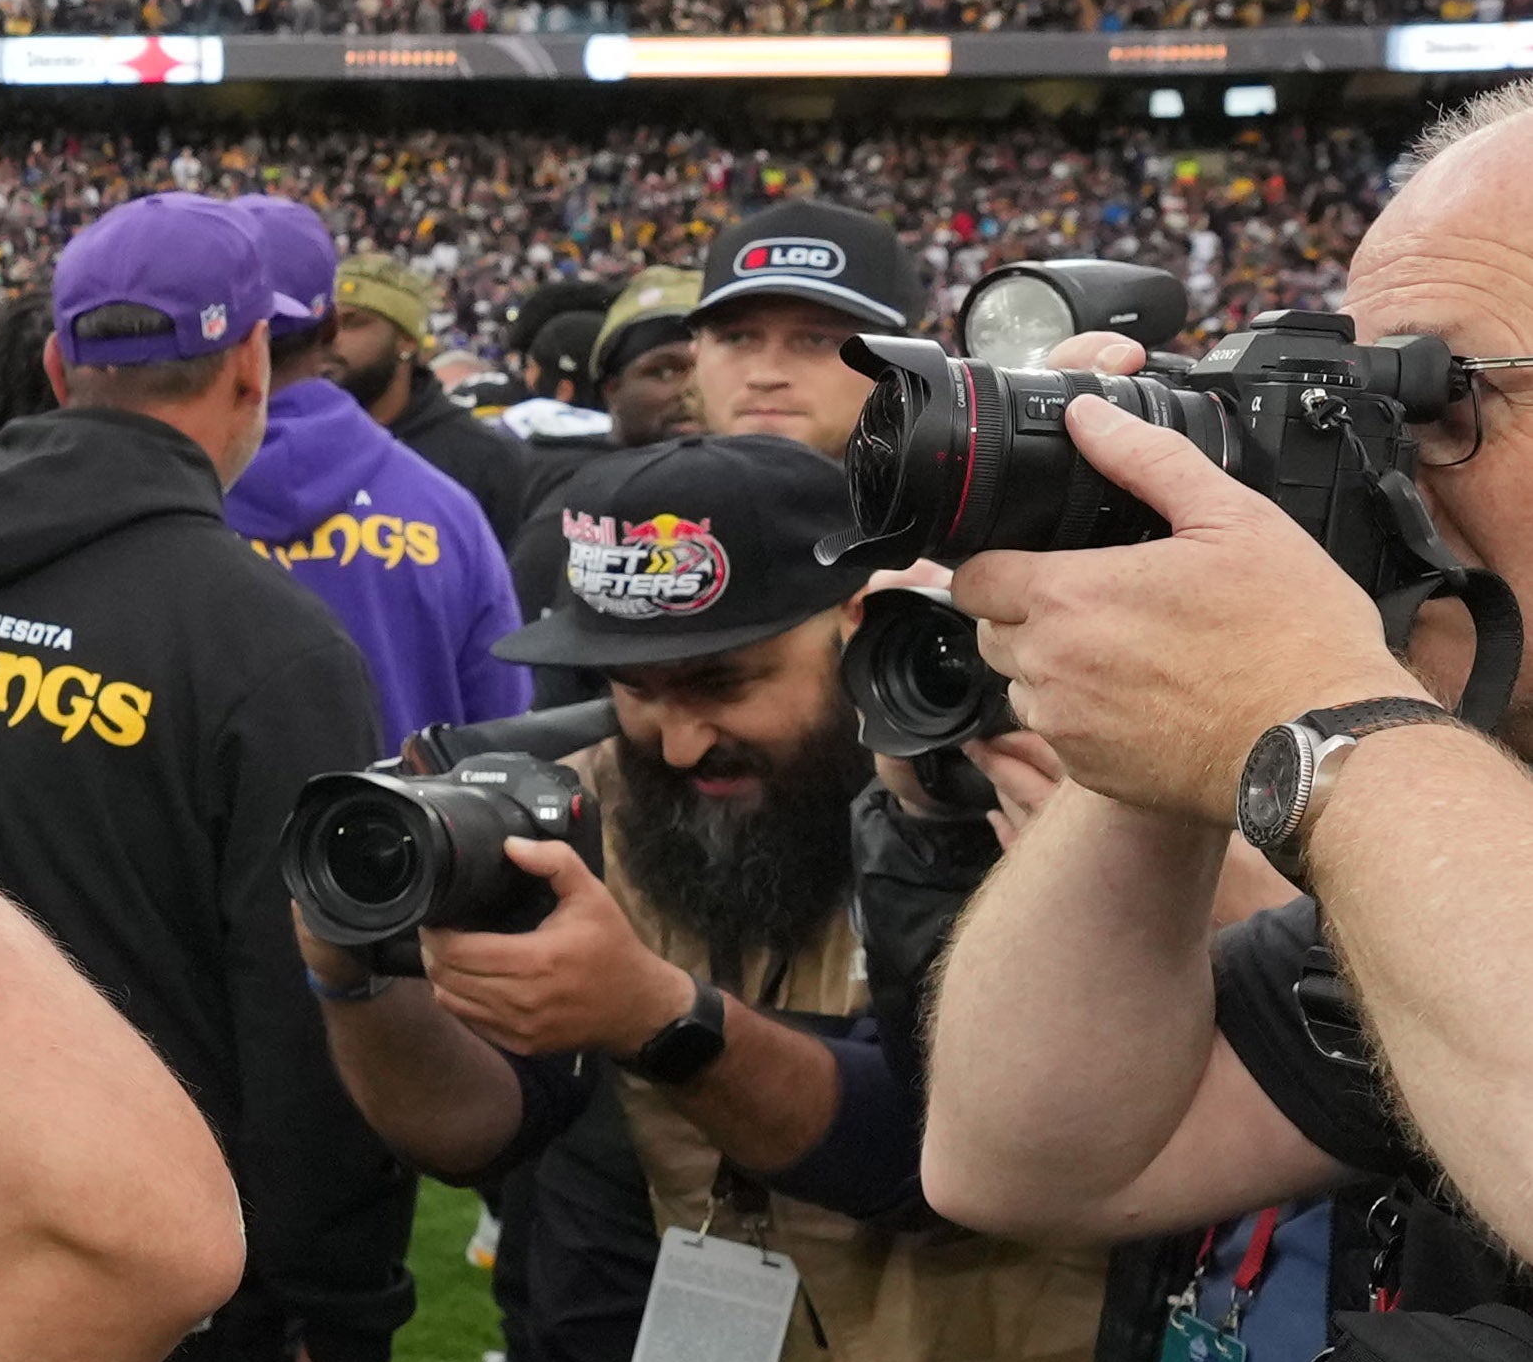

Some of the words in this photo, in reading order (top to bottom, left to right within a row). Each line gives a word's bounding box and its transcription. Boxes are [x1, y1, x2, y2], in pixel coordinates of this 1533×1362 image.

[1208, 349, 1241, 362] SONY
[570, 541, 648, 574] DRIFT
[461, 770, 508, 784] Canon
